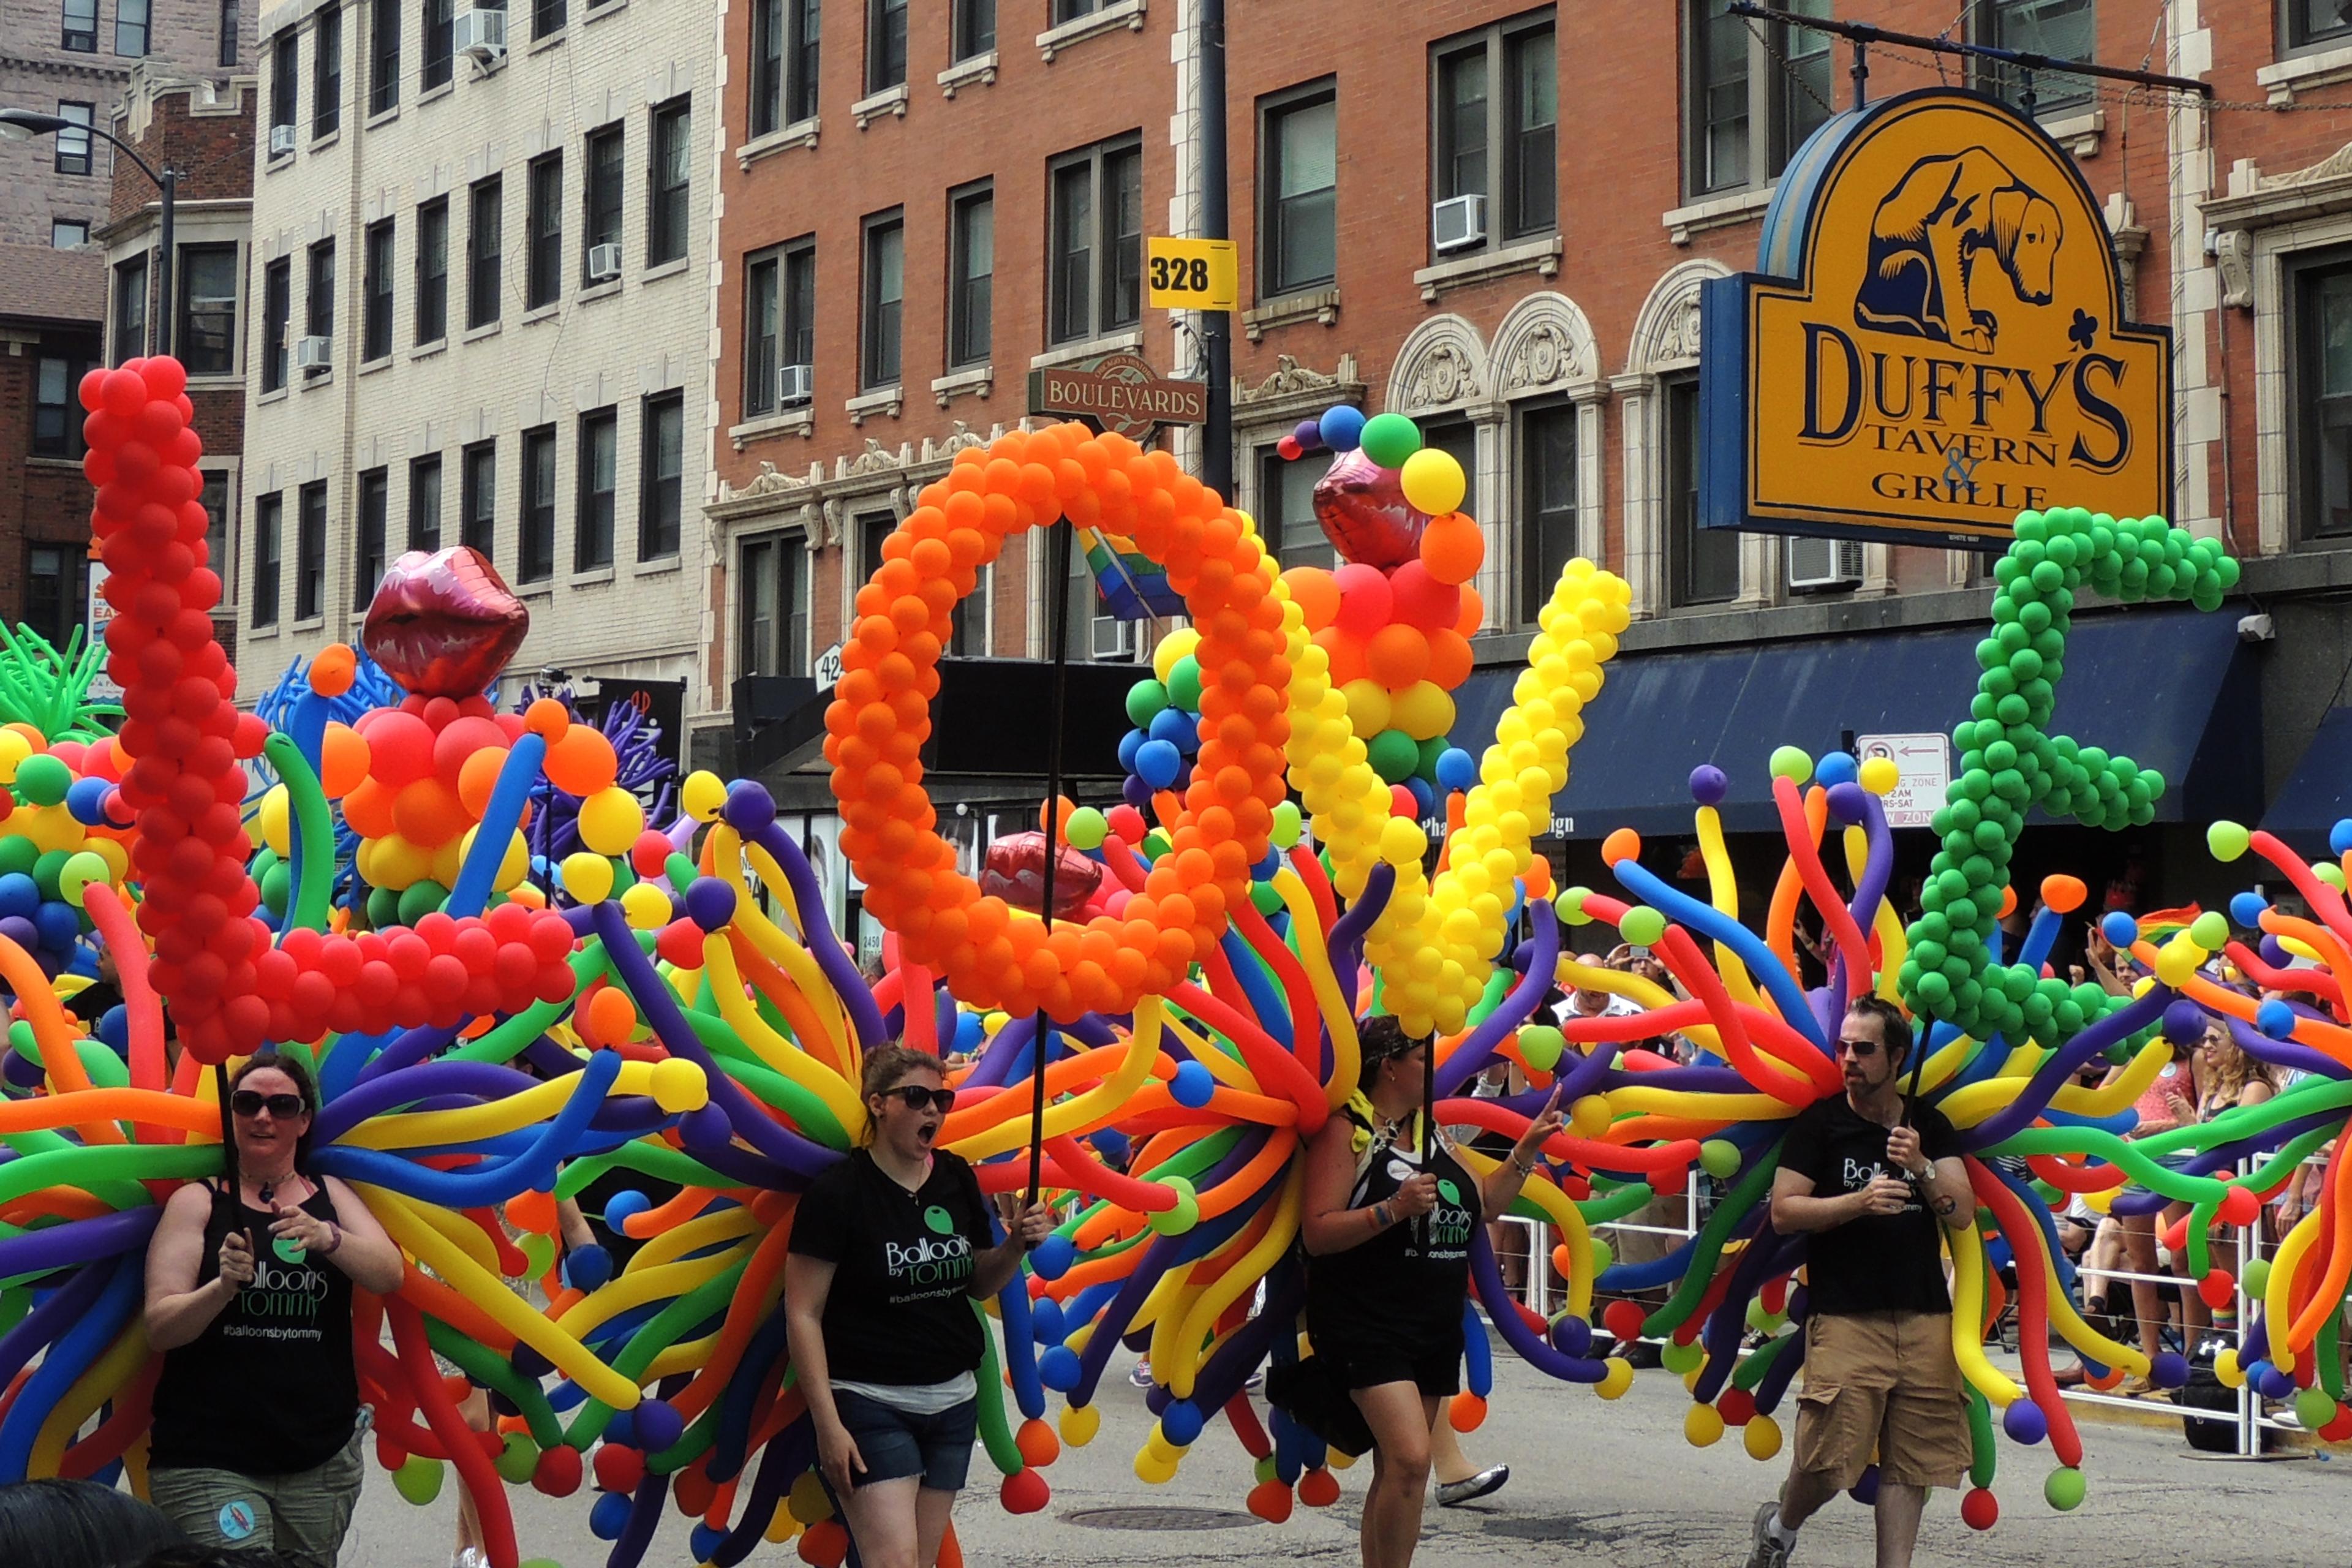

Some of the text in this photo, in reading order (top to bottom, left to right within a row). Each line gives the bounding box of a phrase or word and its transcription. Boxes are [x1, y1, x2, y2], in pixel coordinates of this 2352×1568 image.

[1150, 257, 1208, 292] 328
[1050, 380, 1200, 416] BOULEVARDS
[1865, 423, 2058, 467] TAVERN
[1871, 472, 2049, 511] GRILLE
[1912, 778, 1937, 787] ZONE
[1903, 812, 1931, 823] ZON
[864, 936, 880, 948] 2450
[889, 1266, 904, 1277] by
[224, 1325, 323, 1343] #balloonsbytommy
